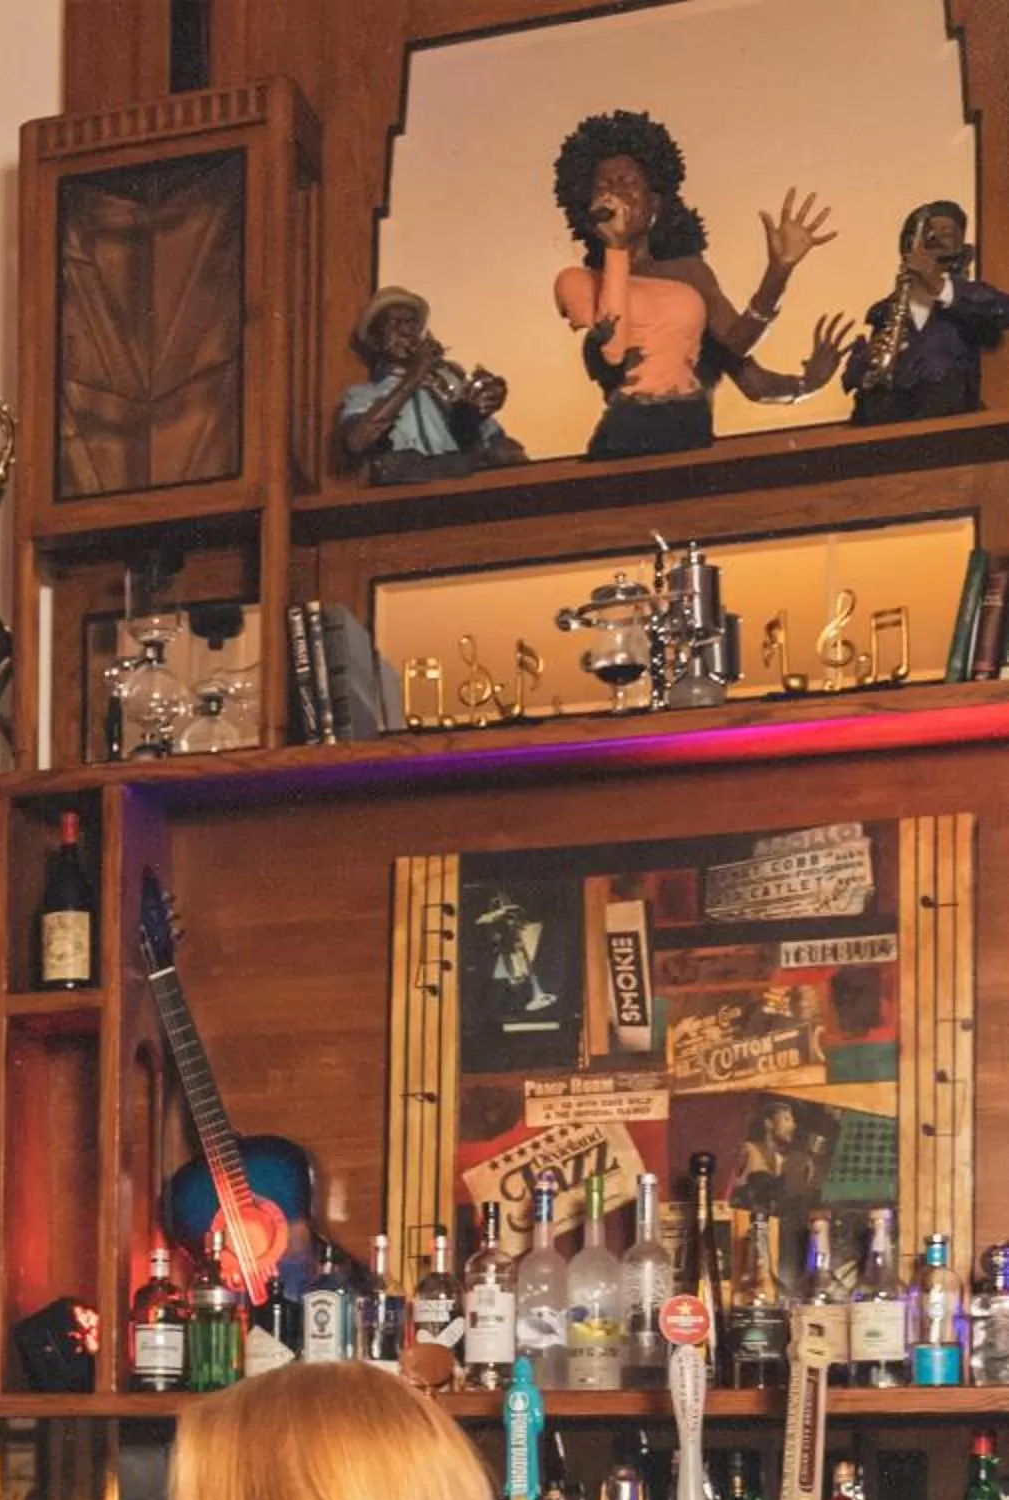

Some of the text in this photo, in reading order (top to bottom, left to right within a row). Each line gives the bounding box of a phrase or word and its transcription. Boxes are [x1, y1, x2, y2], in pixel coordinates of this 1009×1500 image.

[611, 936, 641, 1022] SMOKE
[709, 1036, 774, 1080] COTTON
[757, 1048, 800, 1073] CLUB
